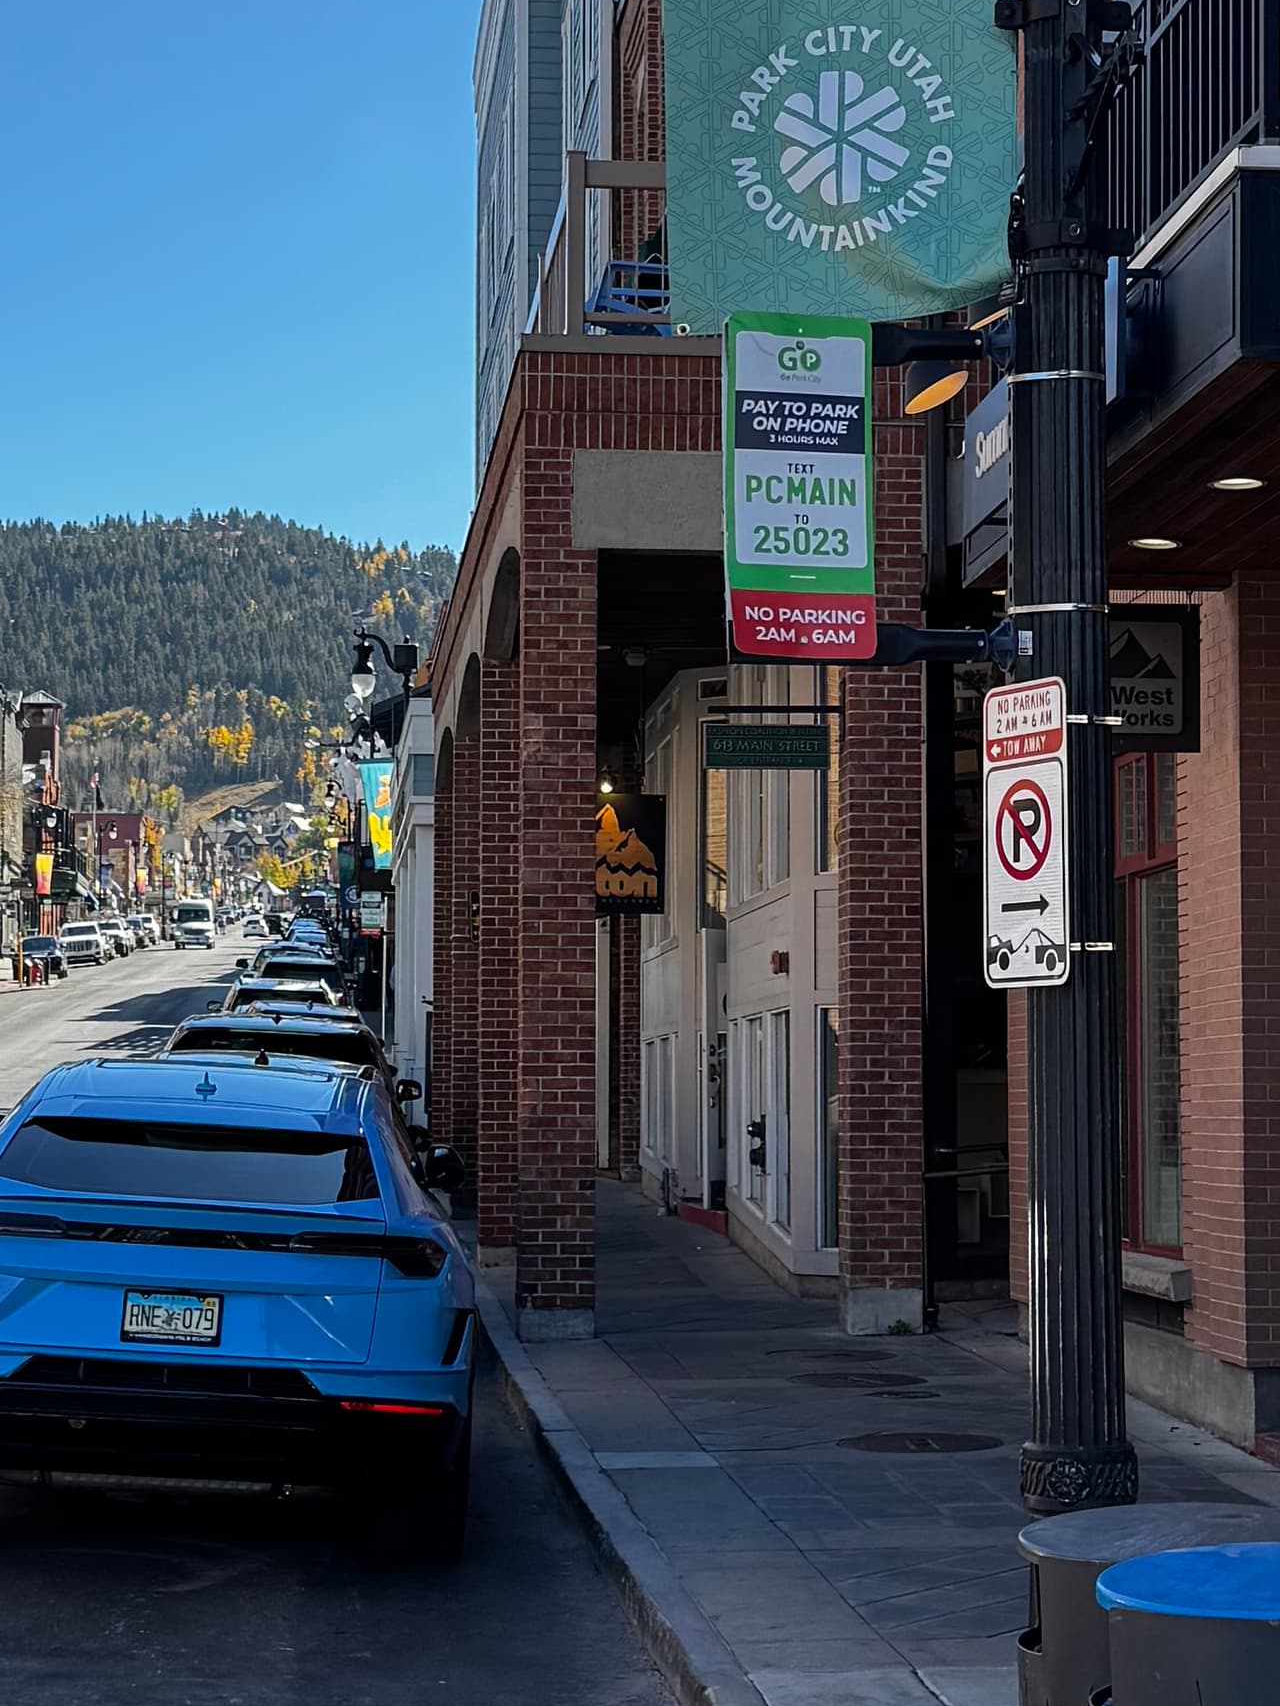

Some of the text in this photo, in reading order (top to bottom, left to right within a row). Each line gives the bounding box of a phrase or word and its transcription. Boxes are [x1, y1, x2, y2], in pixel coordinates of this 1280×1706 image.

[731, 25, 956, 132] PARK CITY UTAH
[731, 145, 953, 251] MOUNTAINKIND
[741, 399, 860, 419] PAY TO PARK
[753, 416, 849, 434] ON PHONE
[769, 434, 839, 445] 3 HOURS MAX
[787, 463, 815, 474] TEXT
[745, 475, 856, 506] PCMAIN
[793, 514, 809, 525] TO
[753, 525, 849, 557] 25023
[745, 606, 866, 624] NO PARKING
[755, 626, 796, 642] 2AM
[812, 630, 856, 644] 6AM
[997, 691, 1051, 714] NO PARKING
[1111, 686, 1174, 705] West
[996, 719, 1002, 733] 2
[1005, 716, 1018, 732] AM
[1031, 713, 1037, 727] 6
[1040, 710, 1052, 725] AM
[713, 739, 820, 752] 613 MAIN STREET
[1003, 735, 1047, 757] TOW AWAY
[183, 1308, 215, 1330] 079
